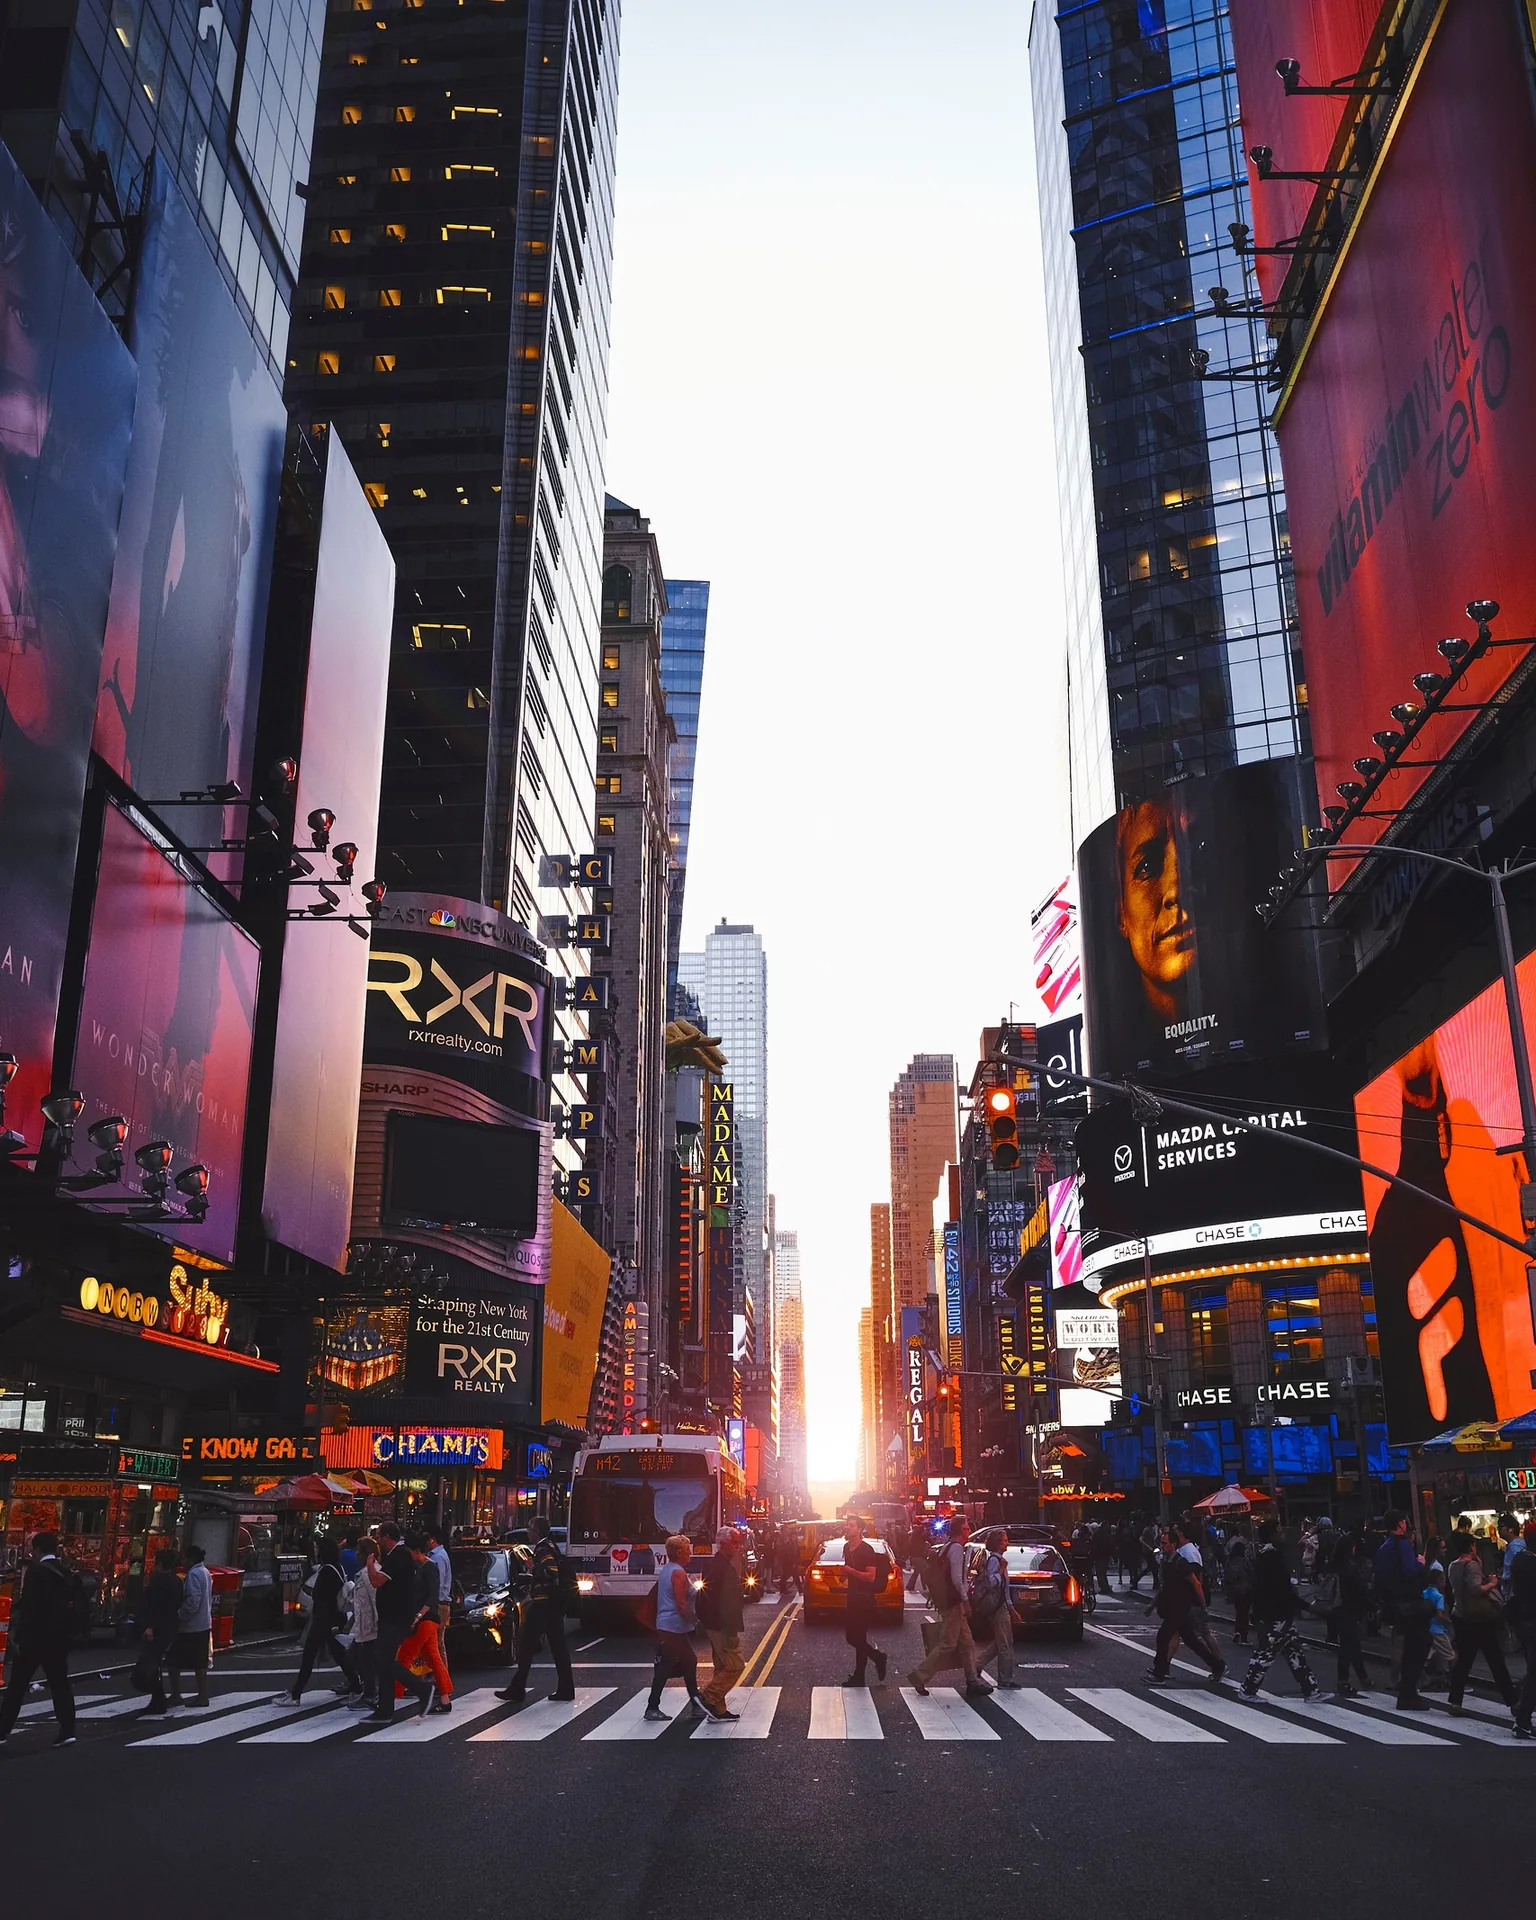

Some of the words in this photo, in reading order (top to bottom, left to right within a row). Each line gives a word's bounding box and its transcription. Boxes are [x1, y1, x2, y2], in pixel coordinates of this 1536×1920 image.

[1426, 324, 1512, 521] zero
[367, 951, 538, 1053] RXR
[577, 860, 603, 1197] CHAMPS
[1164, 1013, 1219, 1040] EQUALITY.
[407, 1028, 503, 1058] rxrrealty.com
[92, 1019, 174, 1095] WONDER
[183, 1084, 240, 1135] WOMAN
[361, 1082, 429, 1096] SHARP
[712, 1084, 733, 1204] MADAME
[1157, 1127, 1216, 1150] MAZDA
[1157, 1141, 1237, 1171] SERVICES
[1196, 1225, 1245, 1243] CHASE
[1319, 1213, 1367, 1230] CHAS
[508, 1250, 541, 1267] AQUOS
[1113, 1240, 1144, 1260] CHASE
[417, 1293, 477, 1318] Shaping
[479, 1299, 507, 1316] New
[508, 1303, 528, 1321] York
[947, 1287, 962, 1335] STUDIOS
[1029, 1285, 1046, 1352] VICTORY
[415, 1316, 439, 1333] for
[442, 1317, 465, 1335] the
[467, 1320, 491, 1337] 21st
[493, 1323, 531, 1346] Century
[1001, 1318, 1014, 1360] CTORY
[1065, 1323, 1116, 1334] WORK
[437, 1343, 517, 1383] RXR
[454, 1380, 505, 1393] REALTY
[908, 1350, 924, 1442] REGAL
[1003, 1382, 1016, 1412] NEW
[1177, 1387, 1232, 1407] CHASE
[1257, 1381, 1331, 1402] CHASE
[1025, 1421, 1060, 1435] SKCHERS
[200, 1436, 259, 1460] KNOW
[373, 1433, 490, 1463] CHAMPS
[596, 1455, 621, 1471] M42
[638, 1454, 656, 1464] EAST
[657, 1454, 674, 1464] SIDE
[15, 1485, 56, 1493] HALAL
[71, 1485, 107, 1493] FOOD
